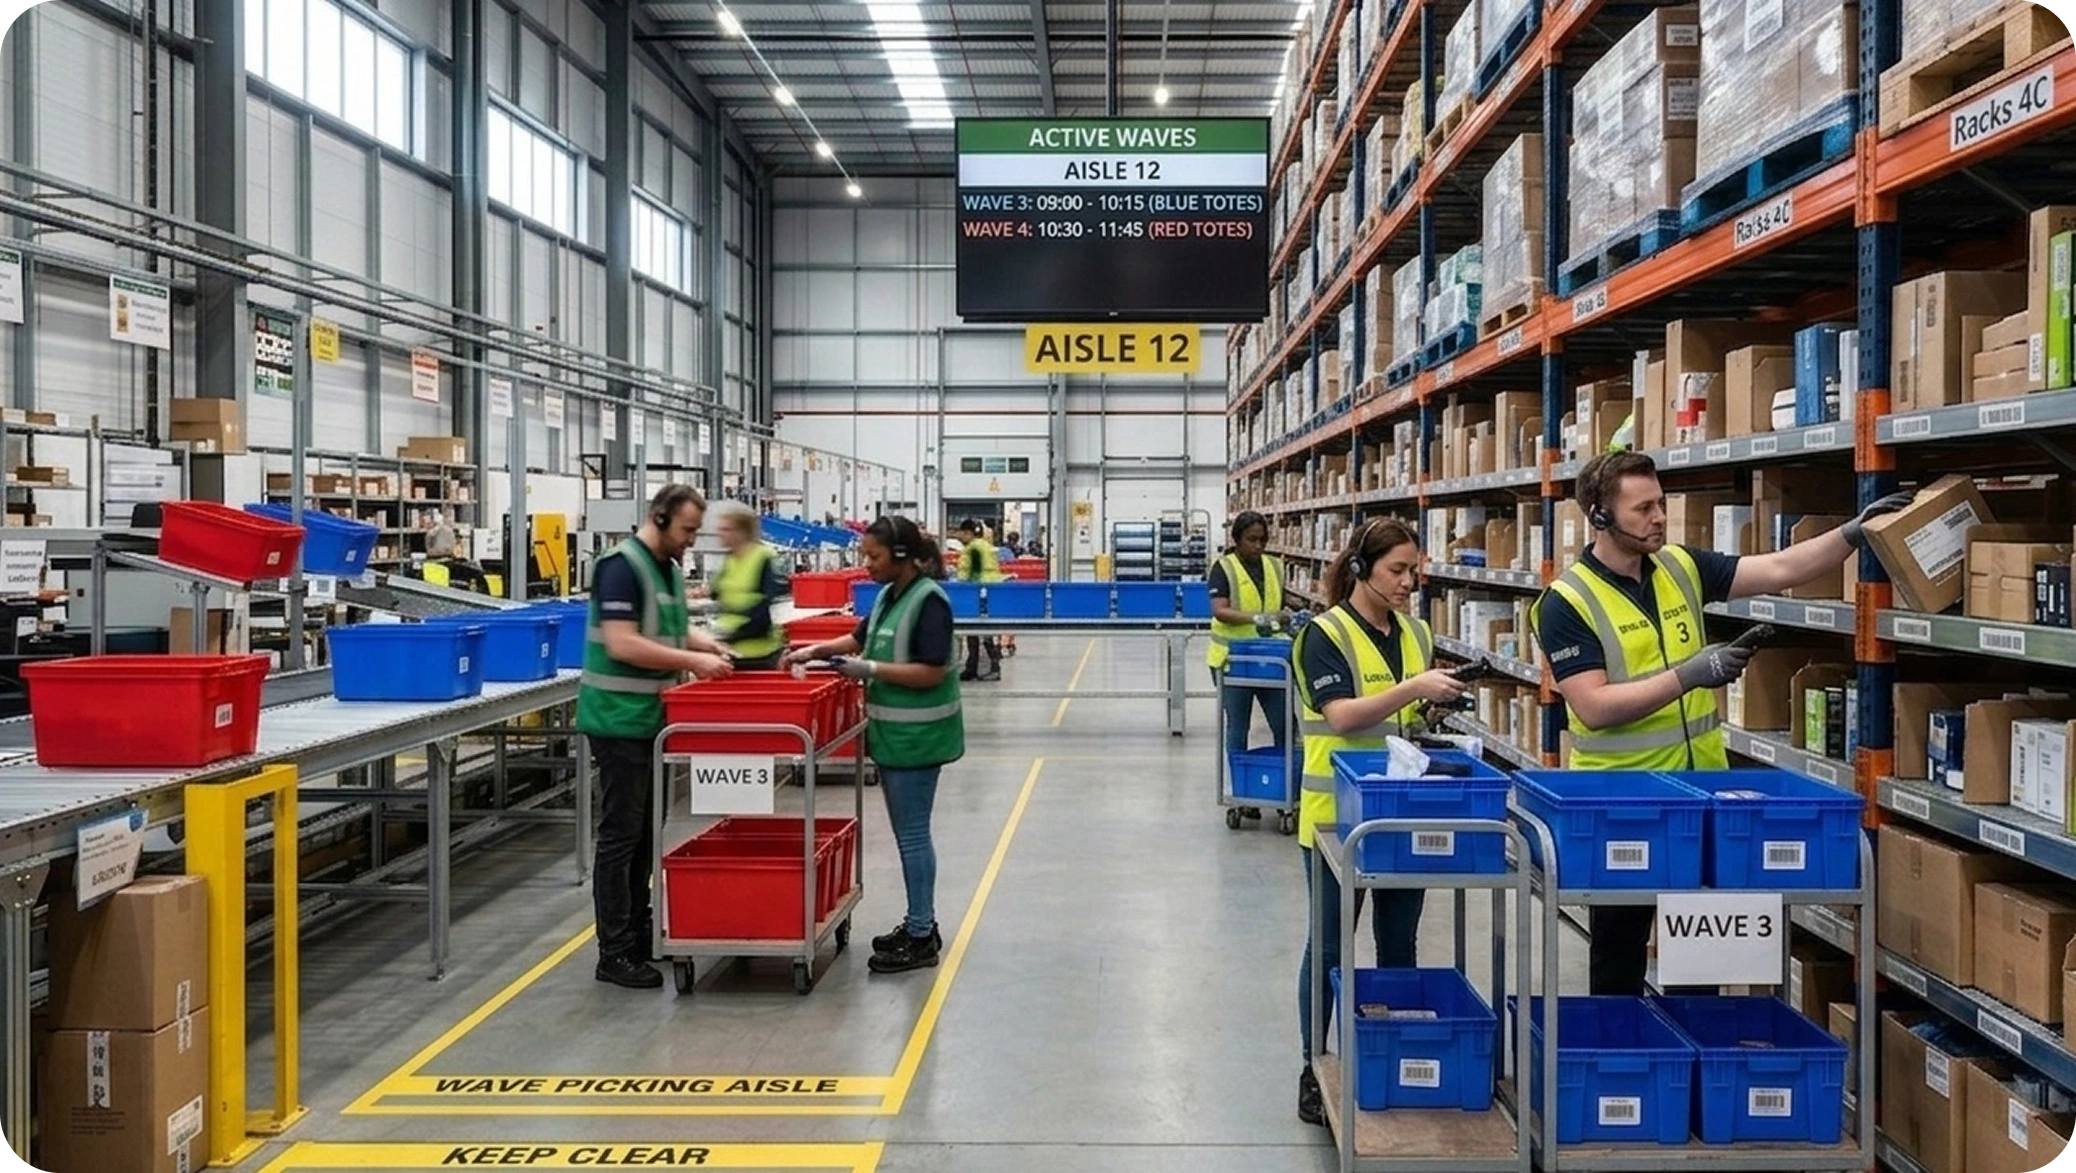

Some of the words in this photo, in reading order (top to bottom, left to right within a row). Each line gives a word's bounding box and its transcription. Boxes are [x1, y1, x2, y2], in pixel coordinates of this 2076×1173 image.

[1955, 99, 2012, 145] Racks
[2018, 75, 2048, 113] 4C
[1029, 127, 1110, 148] ACTIVE
[1116, 127, 1197, 148] WAVES
[1064, 160, 1127, 180] AISLE
[1135, 160, 1161, 180] 12
[962, 194, 1014, 211] WAVE
[1017, 194, 1034, 211] 3:
[1036, 194, 1083, 211] 09:00
[1098, 194, 1145, 211] 10:15
[1148, 194, 1199, 214] (BLUE
[1203, 194, 1263, 214] TOTES)
[962, 221, 1014, 238] WAVE
[1016, 221, 1034, 238] 4:
[1037, 221, 1083, 238] 10:30
[1098, 221, 1144, 238] 11:45
[1148, 221, 1189, 241] (RED
[1193, 221, 1253, 241] TOTES)
[1035, 333, 1136, 363] AISLE
[1149, 333, 1189, 363] 12
[1676, 622, 1690, 643] 3
[696, 768, 752, 784] WAVE
[757, 768, 768, 784] 3
[1665, 914, 1749, 938] WAVE
[1757, 914, 1773, 938] 3
[435, 1079, 546, 1093] WAVE
[553, 1079, 715, 1093] PICKING
[724, 1079, 839, 1093] AISLE
[442, 1147, 557, 1166] KEEP
[567, 1147, 711, 1166] CLEAR
